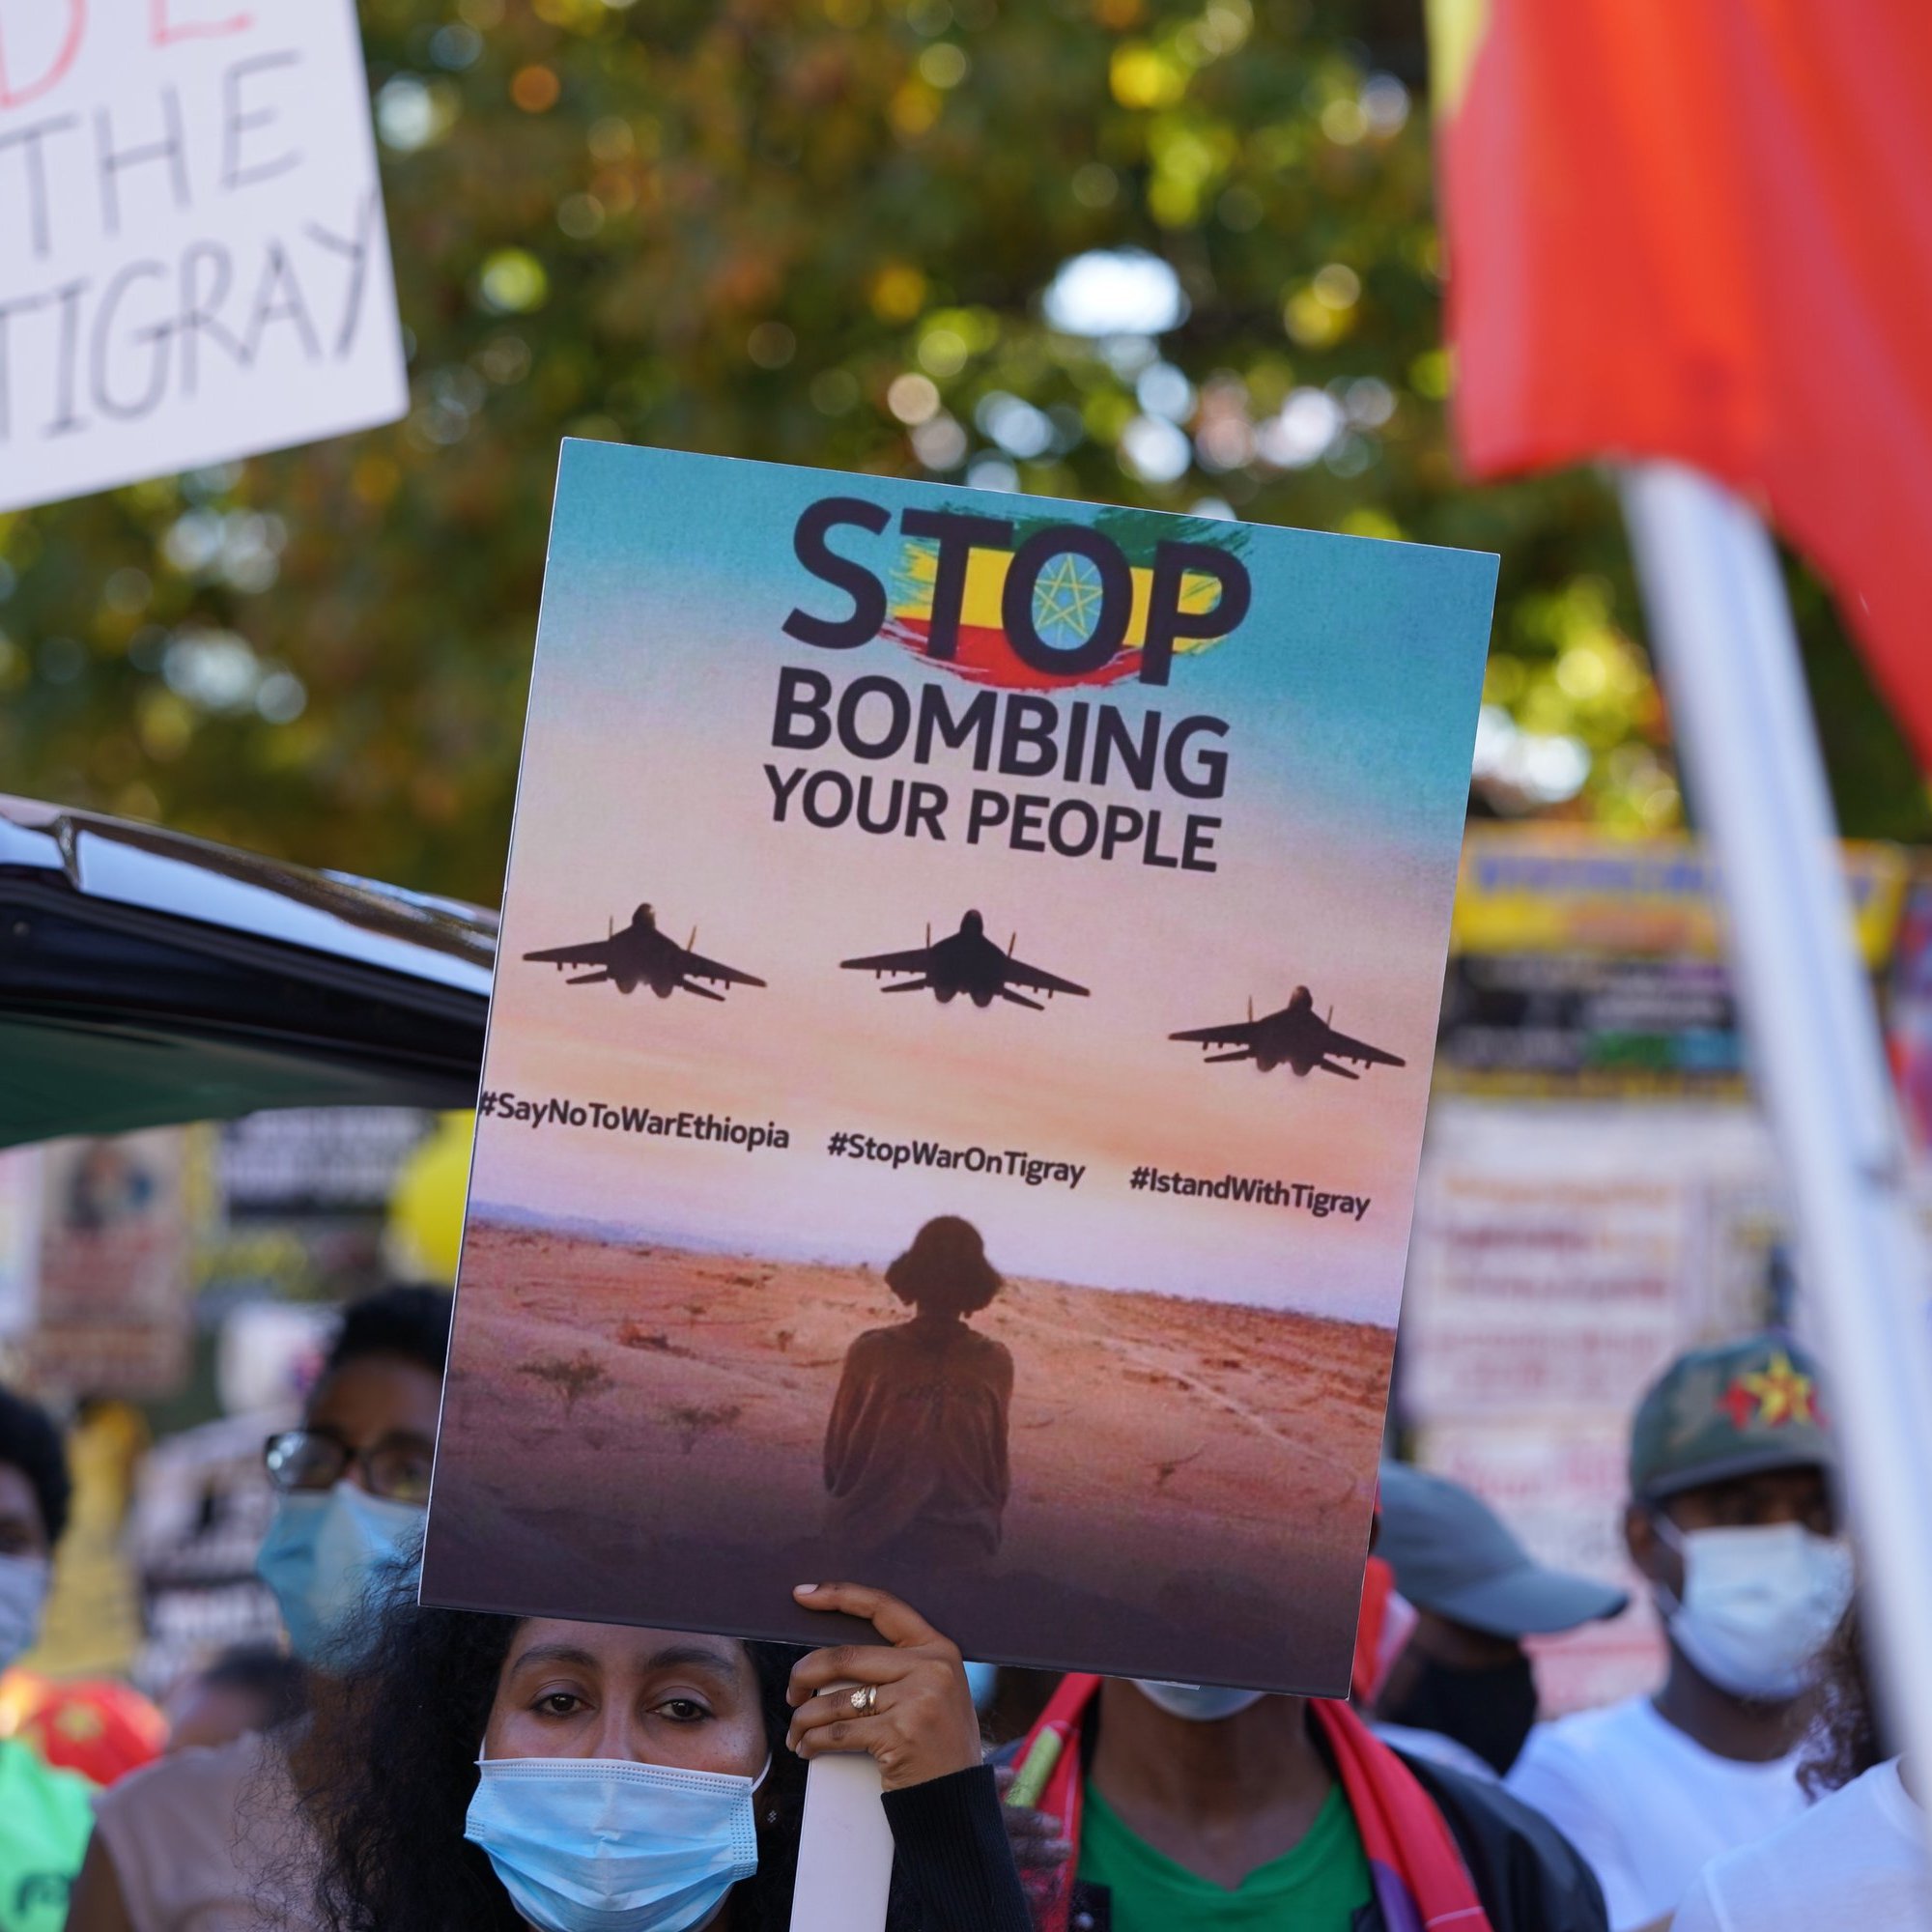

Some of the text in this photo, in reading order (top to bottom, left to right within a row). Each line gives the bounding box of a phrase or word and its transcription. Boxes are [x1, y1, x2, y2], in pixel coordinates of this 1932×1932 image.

[0, 48, 305, 261] THE
[781, 497, 1252, 687] STOP
[771, 666, 1231, 800] BOMBING
[763, 764, 1223, 873] YOUR PEOPLE
[481, 1090, 1372, 1221] #SayNoToWarEthiopia #StopWarOnTigray #IstandWithTigray
